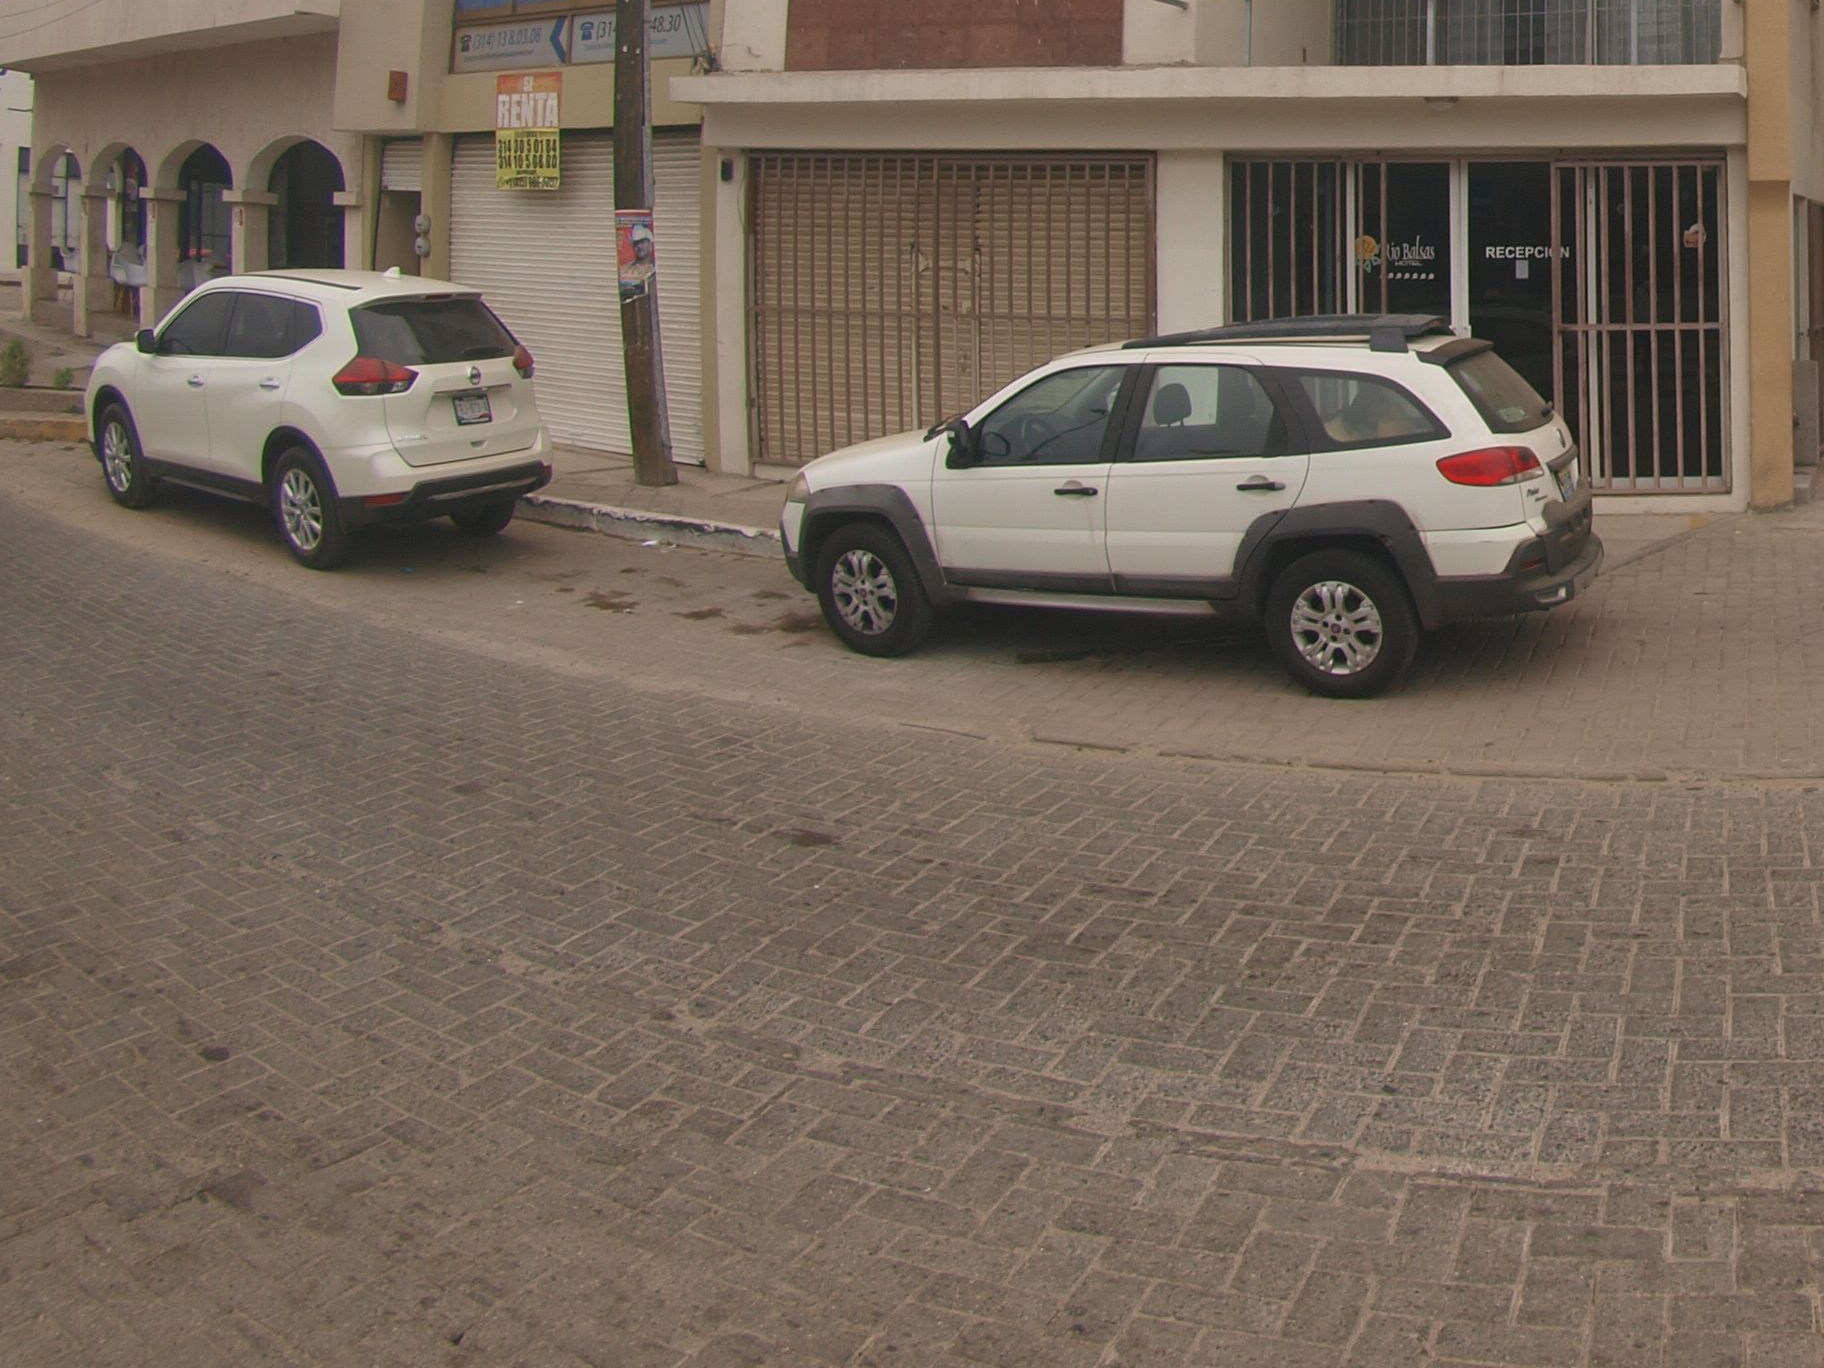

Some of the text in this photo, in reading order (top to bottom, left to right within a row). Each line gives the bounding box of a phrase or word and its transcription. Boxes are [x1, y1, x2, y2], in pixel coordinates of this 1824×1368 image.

[596, 20, 616, 41] (31
[523, 76, 534, 92] SE
[498, 92, 559, 128] RENTA
[1403, 235, 1435, 260] Balsas
[1485, 246, 1570, 258] RECEPCIN
